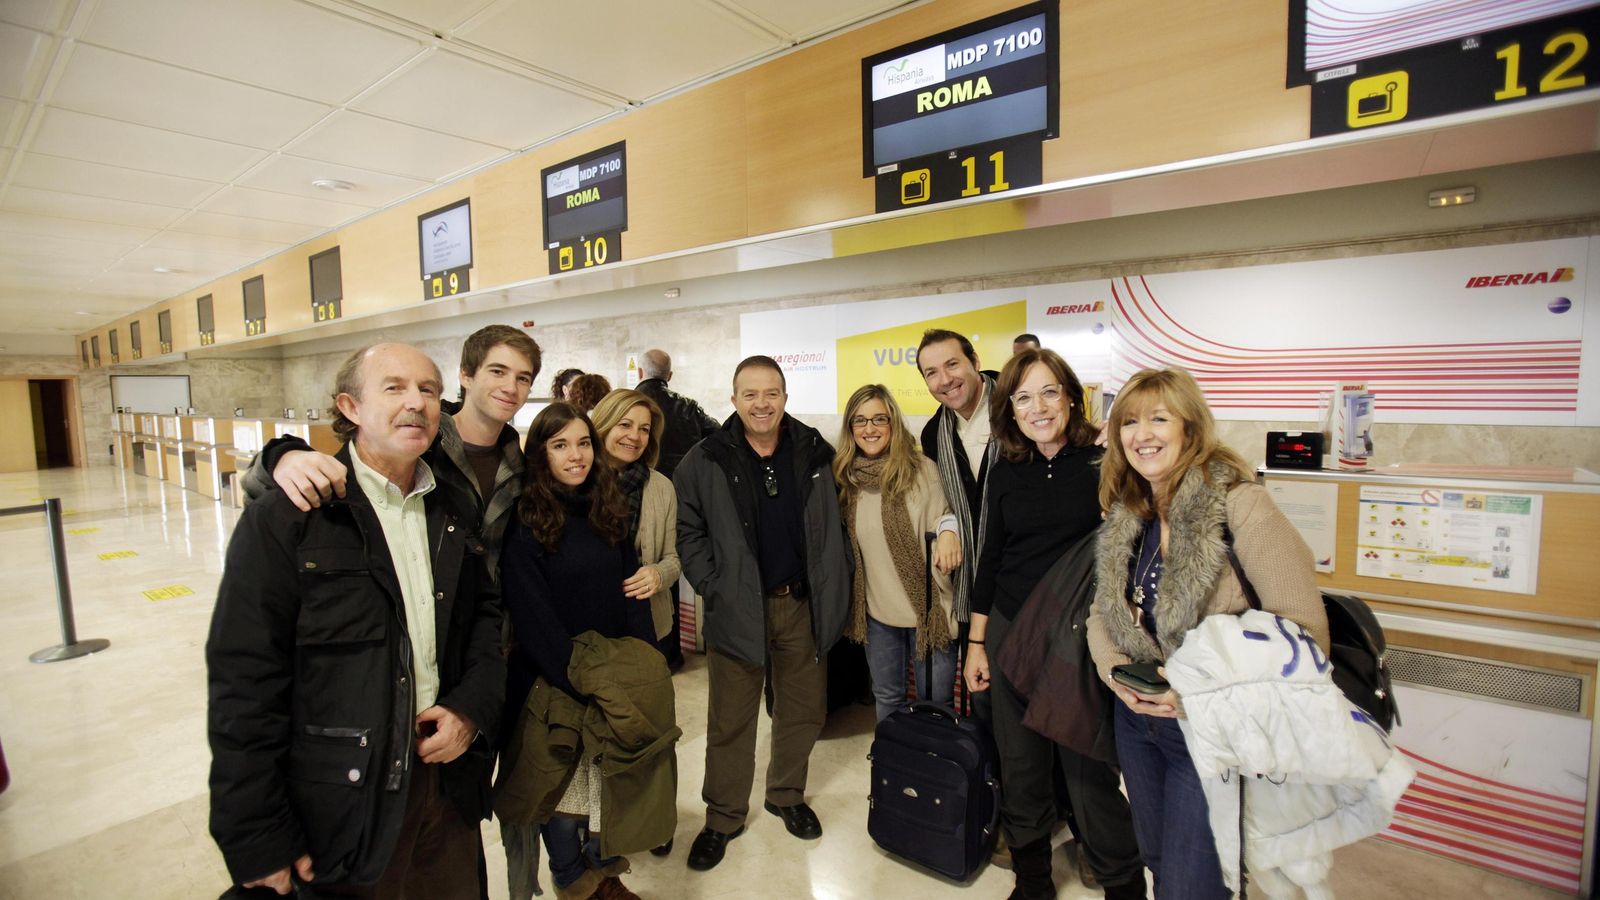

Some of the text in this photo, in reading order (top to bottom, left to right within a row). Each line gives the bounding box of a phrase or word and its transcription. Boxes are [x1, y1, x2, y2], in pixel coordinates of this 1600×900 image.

[947, 27, 1043, 71] MDP 7100
[887, 67, 924, 86] Hispania
[1494, 32, 1589, 101] 12
[917, 76, 993, 113] ROMA
[580, 159, 620, 181] MDP 7100
[961, 151, 1010, 197] 11
[566, 187, 600, 208] ROMA
[584, 237, 607, 267] 10
[449, 273, 458, 294] 9
[1465, 272, 1549, 289] IBERIA
[329, 302, 335, 319] 8
[1046, 303, 1091, 315] IBERIA
[874, 347, 918, 366] vue
